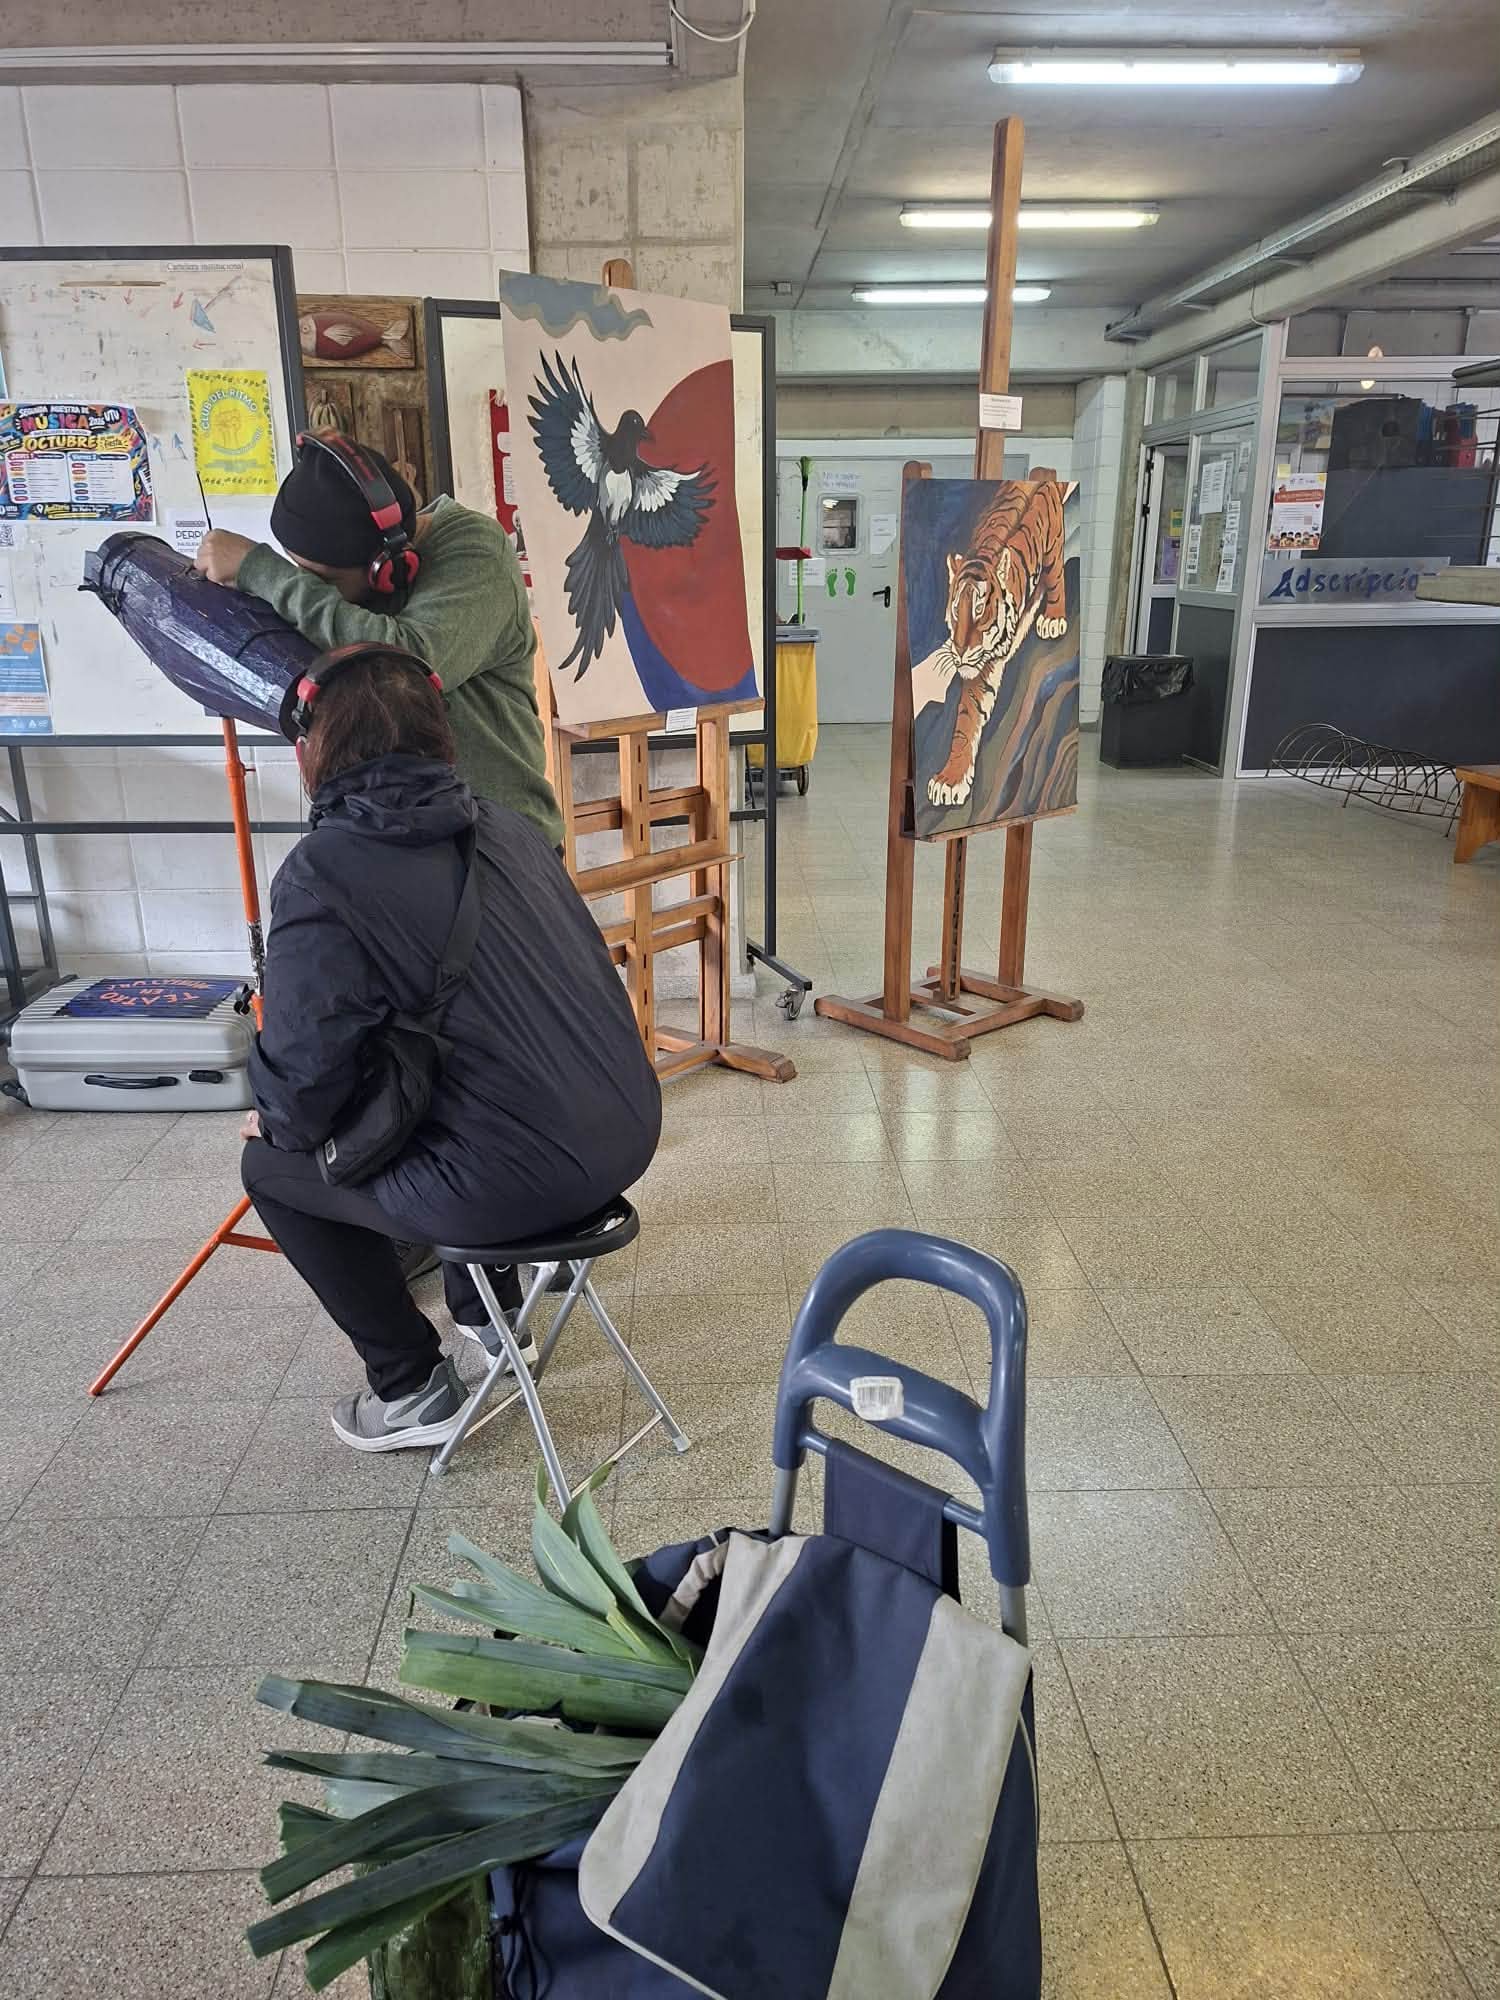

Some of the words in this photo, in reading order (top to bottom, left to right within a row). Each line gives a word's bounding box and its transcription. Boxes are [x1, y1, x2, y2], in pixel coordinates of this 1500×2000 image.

[20, 413, 89, 433] MÚSICA
[25, 435, 96, 451] OCTUBRE
[100, 991, 200, 1006] TEATRO
